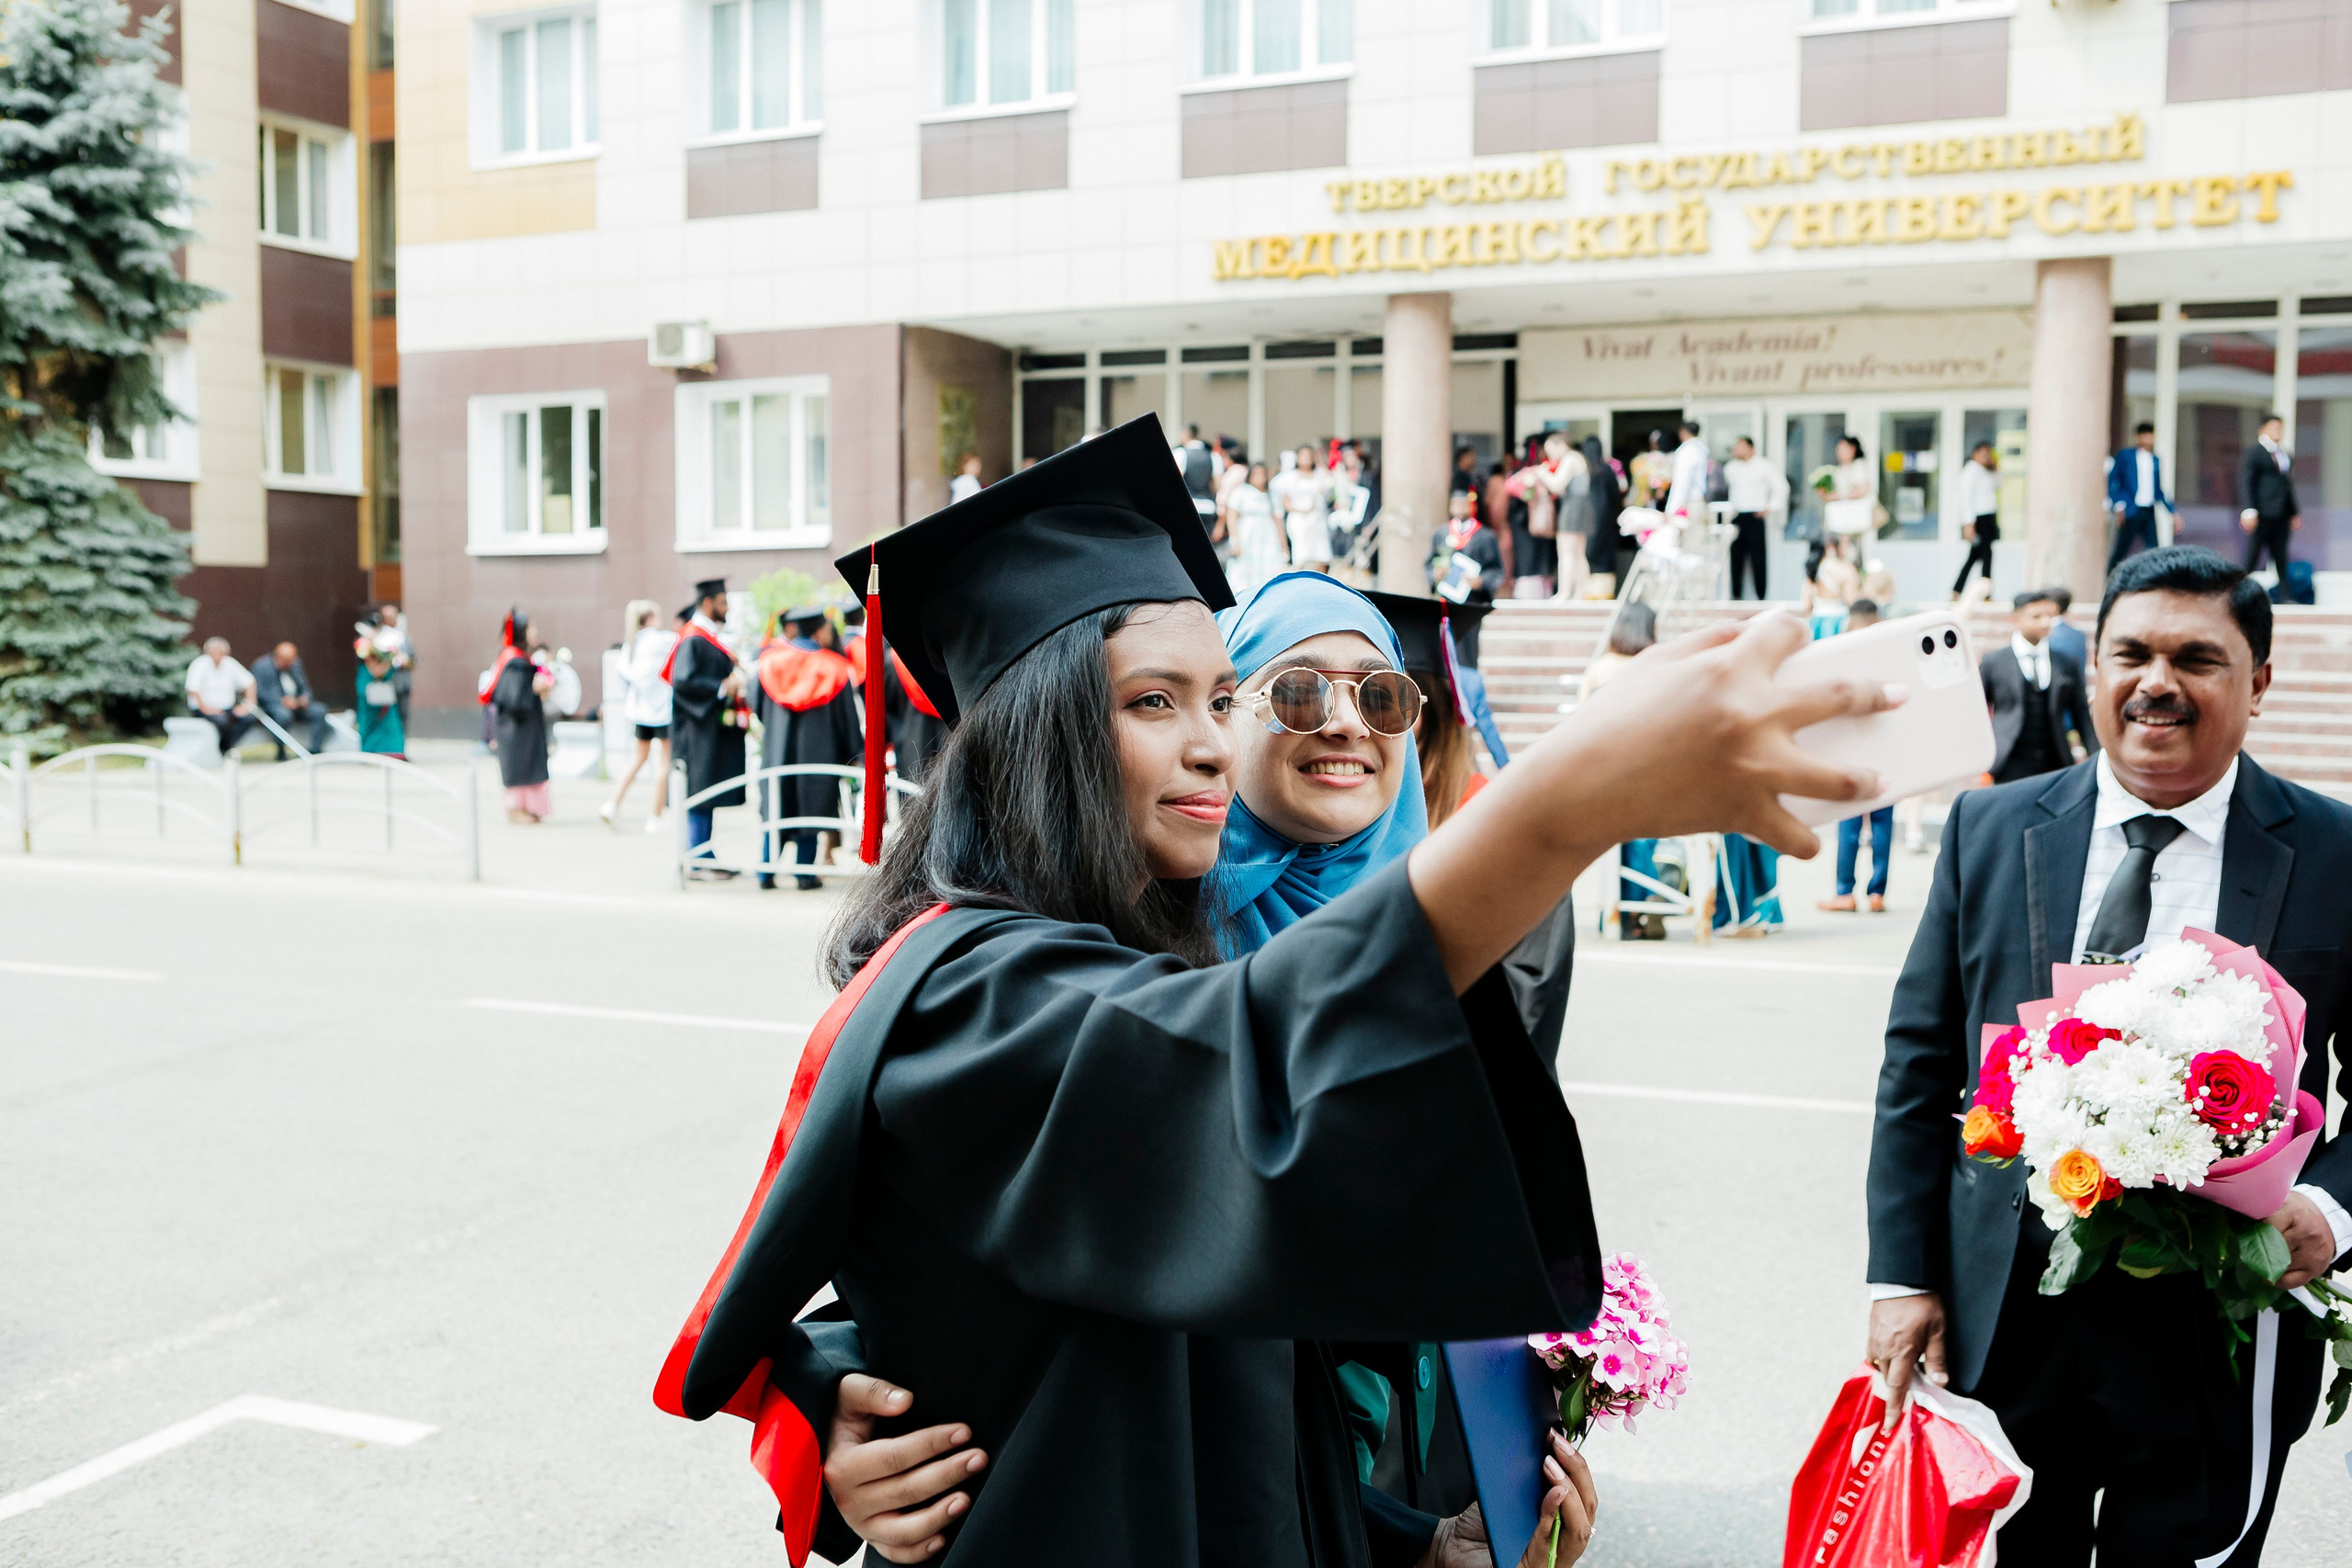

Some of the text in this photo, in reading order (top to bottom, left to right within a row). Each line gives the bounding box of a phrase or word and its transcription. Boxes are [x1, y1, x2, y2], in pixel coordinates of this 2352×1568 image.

[1327, 114, 2144, 212] ТВЕРСКОЙ ГОСУДАРСТВЕННЫЙ
[1210, 171, 2292, 278] МЕДИЦИНСКИЙ УНИВЕРСИТЕТ
[1581, 325, 1837, 360] Vivat Academia!
[1688, 360, 1785, 384] Vivant
